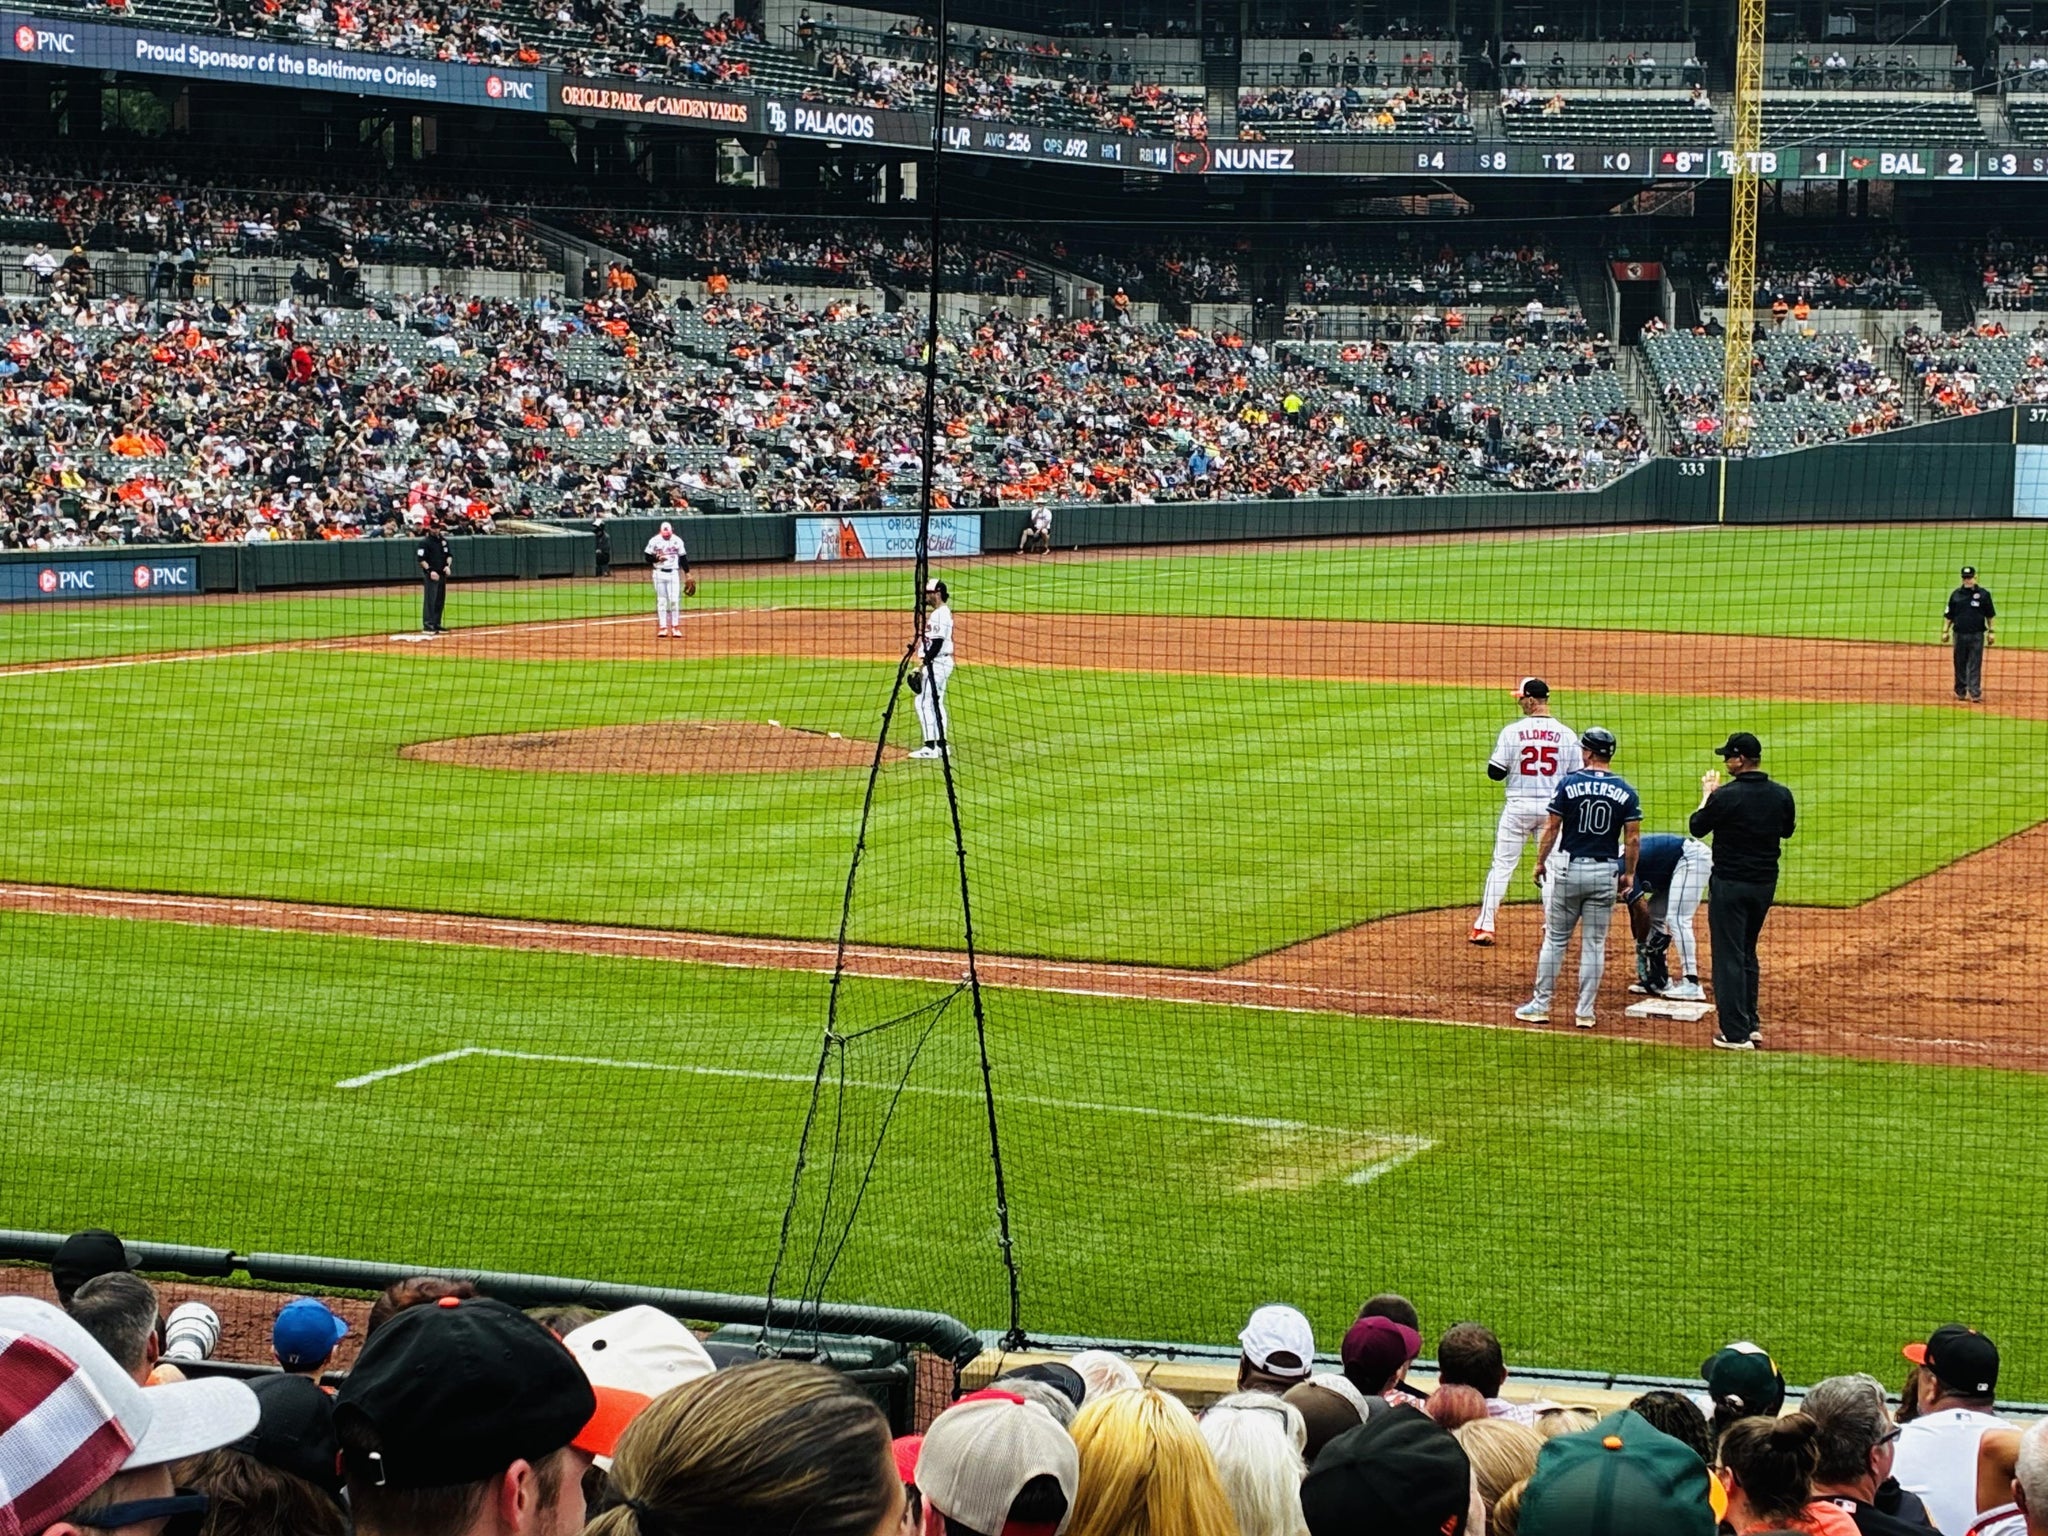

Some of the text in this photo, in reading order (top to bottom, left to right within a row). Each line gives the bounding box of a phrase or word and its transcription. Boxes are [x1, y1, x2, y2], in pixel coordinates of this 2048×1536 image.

[37, 31, 74, 53] PNC
[136, 39, 437, 89] Proud Sponsor of the Baltimore Orioles
[503, 80, 533, 100] PNC
[561, 86, 610, 107] ORIOLE
[611, 91, 643, 112] PARK
[656, 97, 709, 119] CAMDEN
[709, 102, 748, 123] YARDS
[767, 102, 875, 138] TB PALACIOS
[949, 126, 971, 149] L/R
[984, 132, 1005, 148] AVG
[1006, 132, 1031, 152] .256
[1043, 138, 1062, 153] OPS
[1063, 139, 1088, 158] .692
[1101, 144, 1114, 159] HR
[1115, 143, 1121, 161] 1
[1139, 148, 1154, 162] RBI
[1155, 148, 1167, 165] 14
[1214, 149, 1294, 170] NUNEZ
[1418, 152, 1631, 171] B 4 S 8 T 12 K 0
[1746, 152, 1777, 173] TB
[1816, 152, 1827, 174] 1
[1880, 152, 1963, 175] BAL 2
[1988, 157, 1998, 171] B
[2001, 153, 2017, 175] 3
[2033, 157, 2044, 172] S
[2029, 408, 2048, 422] 37
[1678, 462, 1705, 476] 333
[59, 570, 94, 589] PNC
[153, 567, 187, 585] PNC
[1518, 729, 1561, 743] ALONSO
[1520, 746, 1559, 777] 25
[1565, 781, 1630, 805] DICKERSON
[1579, 799, 1612, 835] 10
